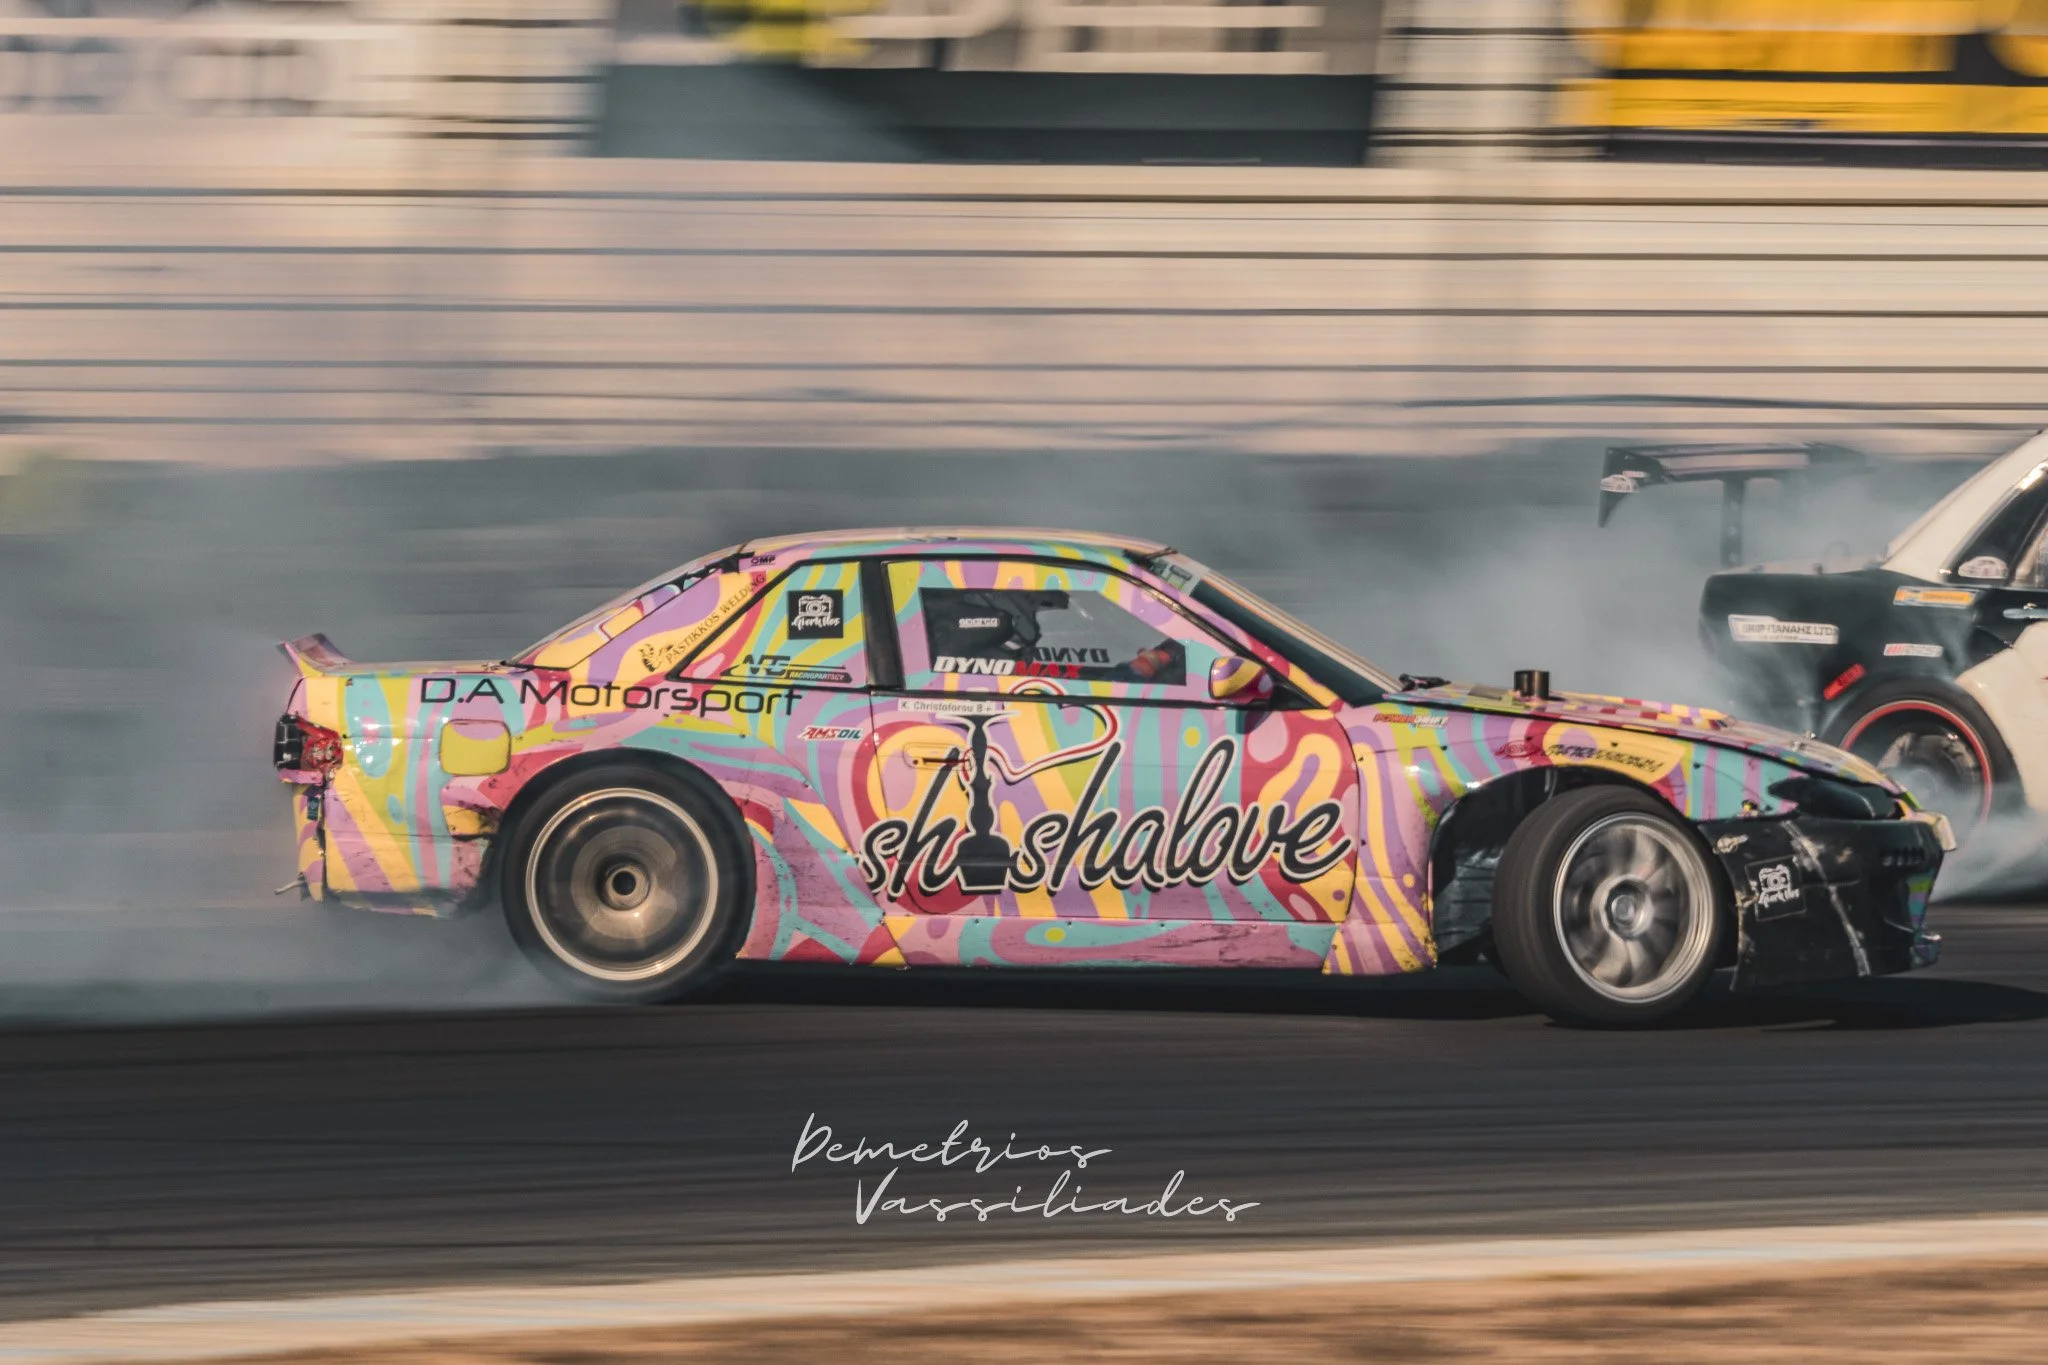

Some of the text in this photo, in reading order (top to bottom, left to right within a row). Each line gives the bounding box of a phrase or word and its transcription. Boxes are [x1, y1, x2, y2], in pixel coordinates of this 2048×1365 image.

[750, 555, 775, 566] OMP
[664, 574, 766, 664] PASTIKKOS WELDING
[933, 655, 1084, 679] DYNOMAX
[420, 677, 803, 717] D.A Motorsport
[804, 725, 861, 740] AMSOIL
